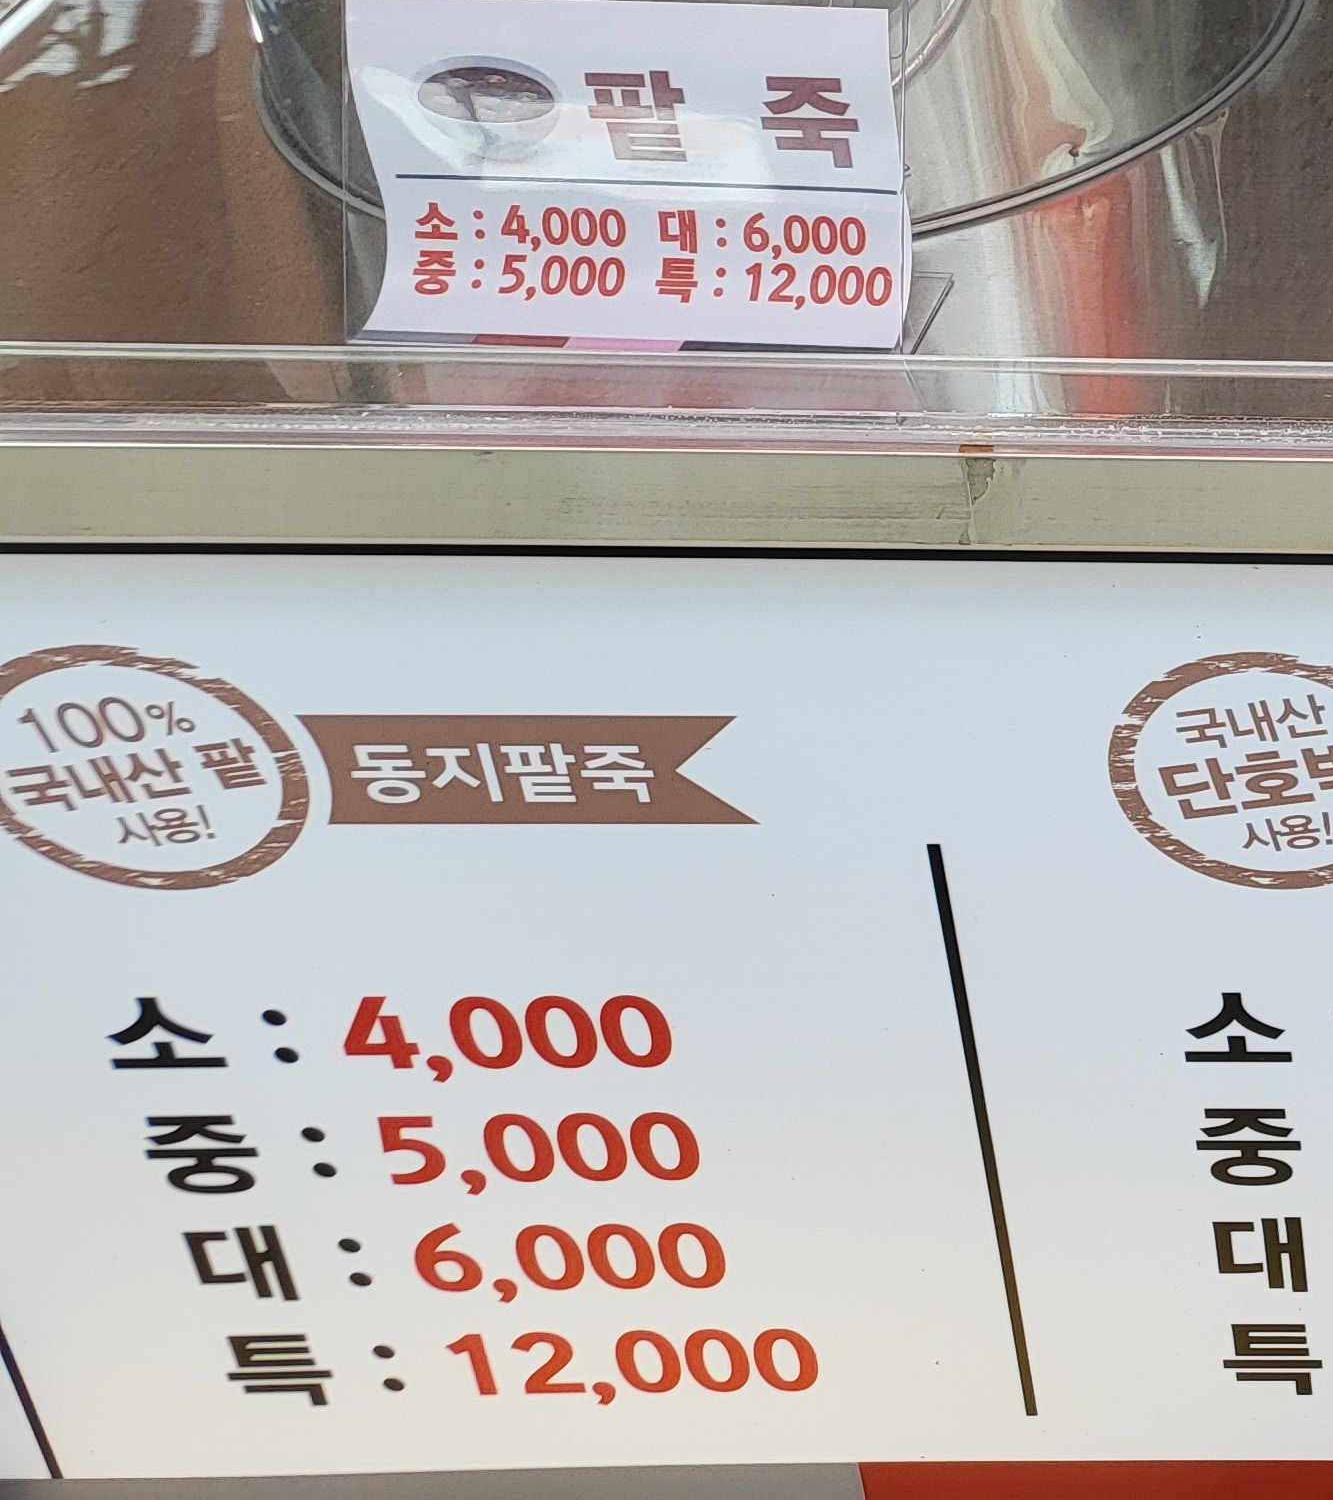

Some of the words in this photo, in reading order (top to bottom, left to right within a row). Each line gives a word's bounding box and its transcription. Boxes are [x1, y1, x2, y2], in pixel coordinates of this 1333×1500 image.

[584, 70, 687, 162] 팥
[760, 76, 860, 168] 죽
[415, 202, 458, 240] 소
[501, 205, 627, 251] 4,000
[658, 210, 698, 254] 대
[743, 212, 866, 260] 6,000
[413, 250, 456, 296] 중
[499, 254, 625, 300] 5,000
[656, 257, 698, 303] 특
[746, 262, 893, 310] 12,000
[17, 697, 200, 758] 100%
[1176, 694, 1328, 748] 국내산
[6, 742, 192, 818] 국내산
[192, 738, 267, 789] 팥
[351, 743, 654, 803] 동지팥죽
[117, 805, 216, 846] 사용!
[1243, 812, 1333, 851] 사용!
[107, 998, 228, 1069] 소
[344, 995, 672, 1083] 4,000
[1185, 993, 1292, 1062] 소
[146, 1115, 258, 1194] 중
[377, 1112, 699, 1195] 5,000
[1196, 1108, 1301, 1186] 중
[183, 1226, 299, 1301] 대
[414, 1223, 725, 1303] 6,000
[1212, 1217, 1308, 1292] 대
[227, 1334, 332, 1406] 특
[446, 1329, 818, 1405] 12,000
[1223, 1324, 1323, 1395] 특
